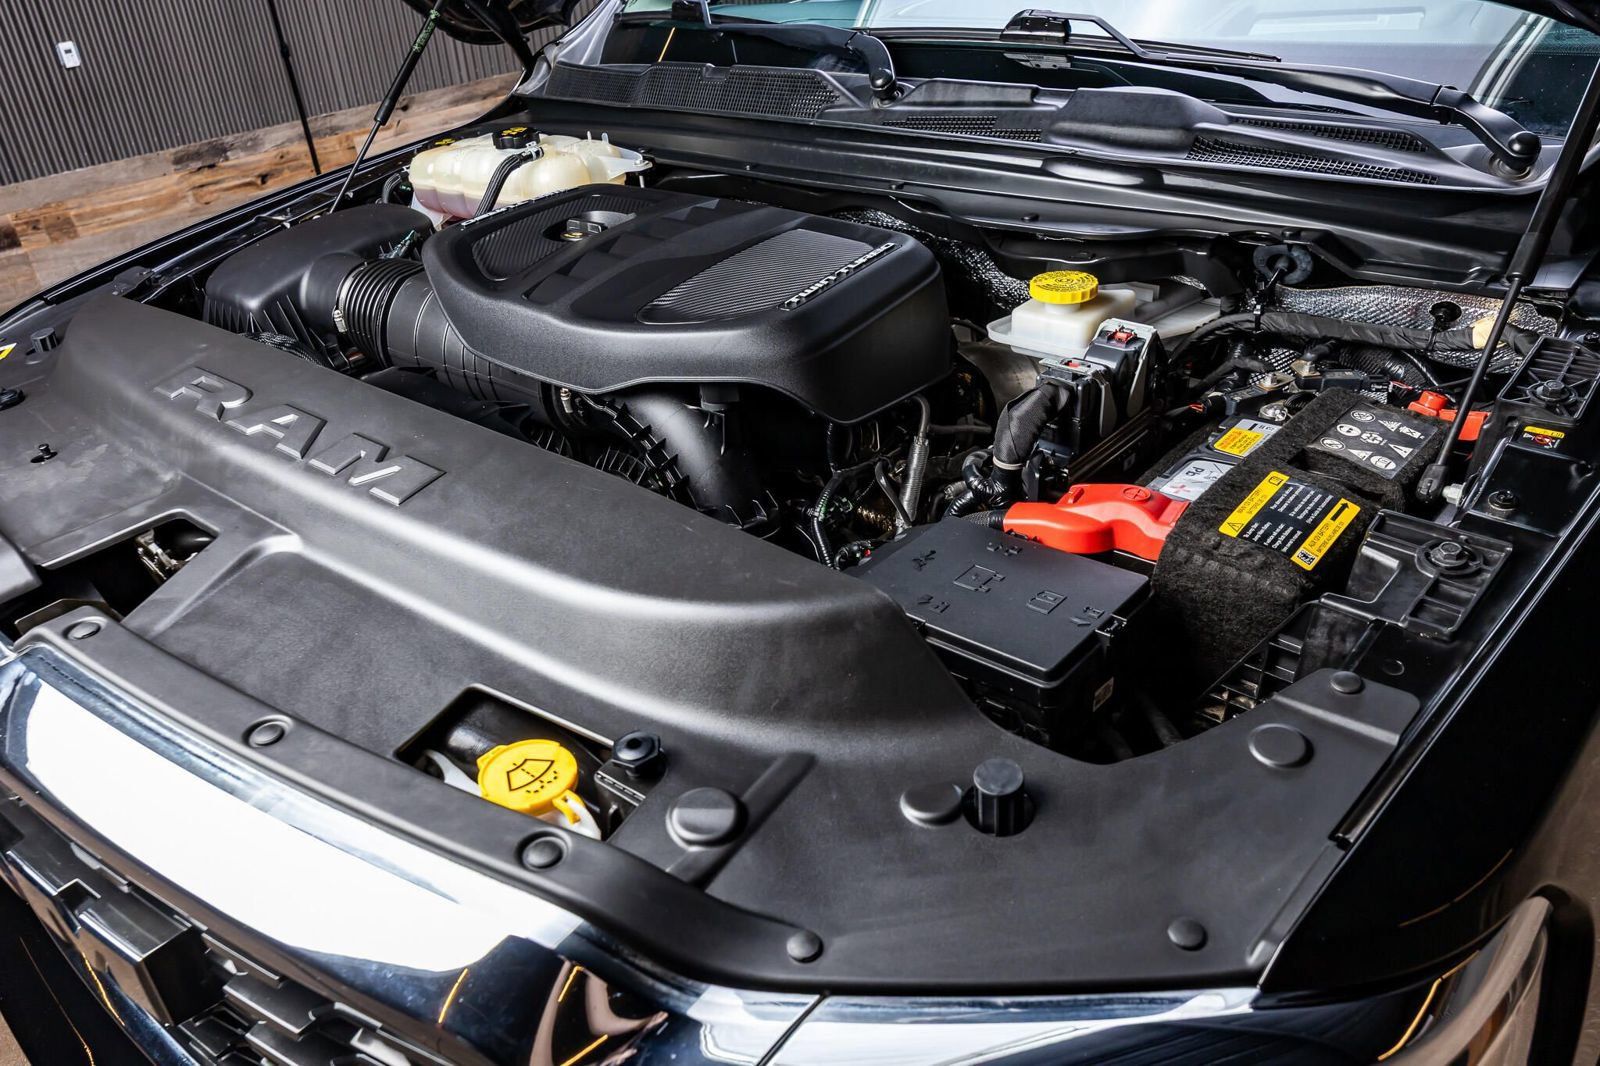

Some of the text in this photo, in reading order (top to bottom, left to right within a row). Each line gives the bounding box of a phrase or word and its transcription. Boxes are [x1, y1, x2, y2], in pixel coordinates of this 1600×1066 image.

[783, 242, 896, 307] TWIN TURBO
[154, 366, 447, 506] RAM
